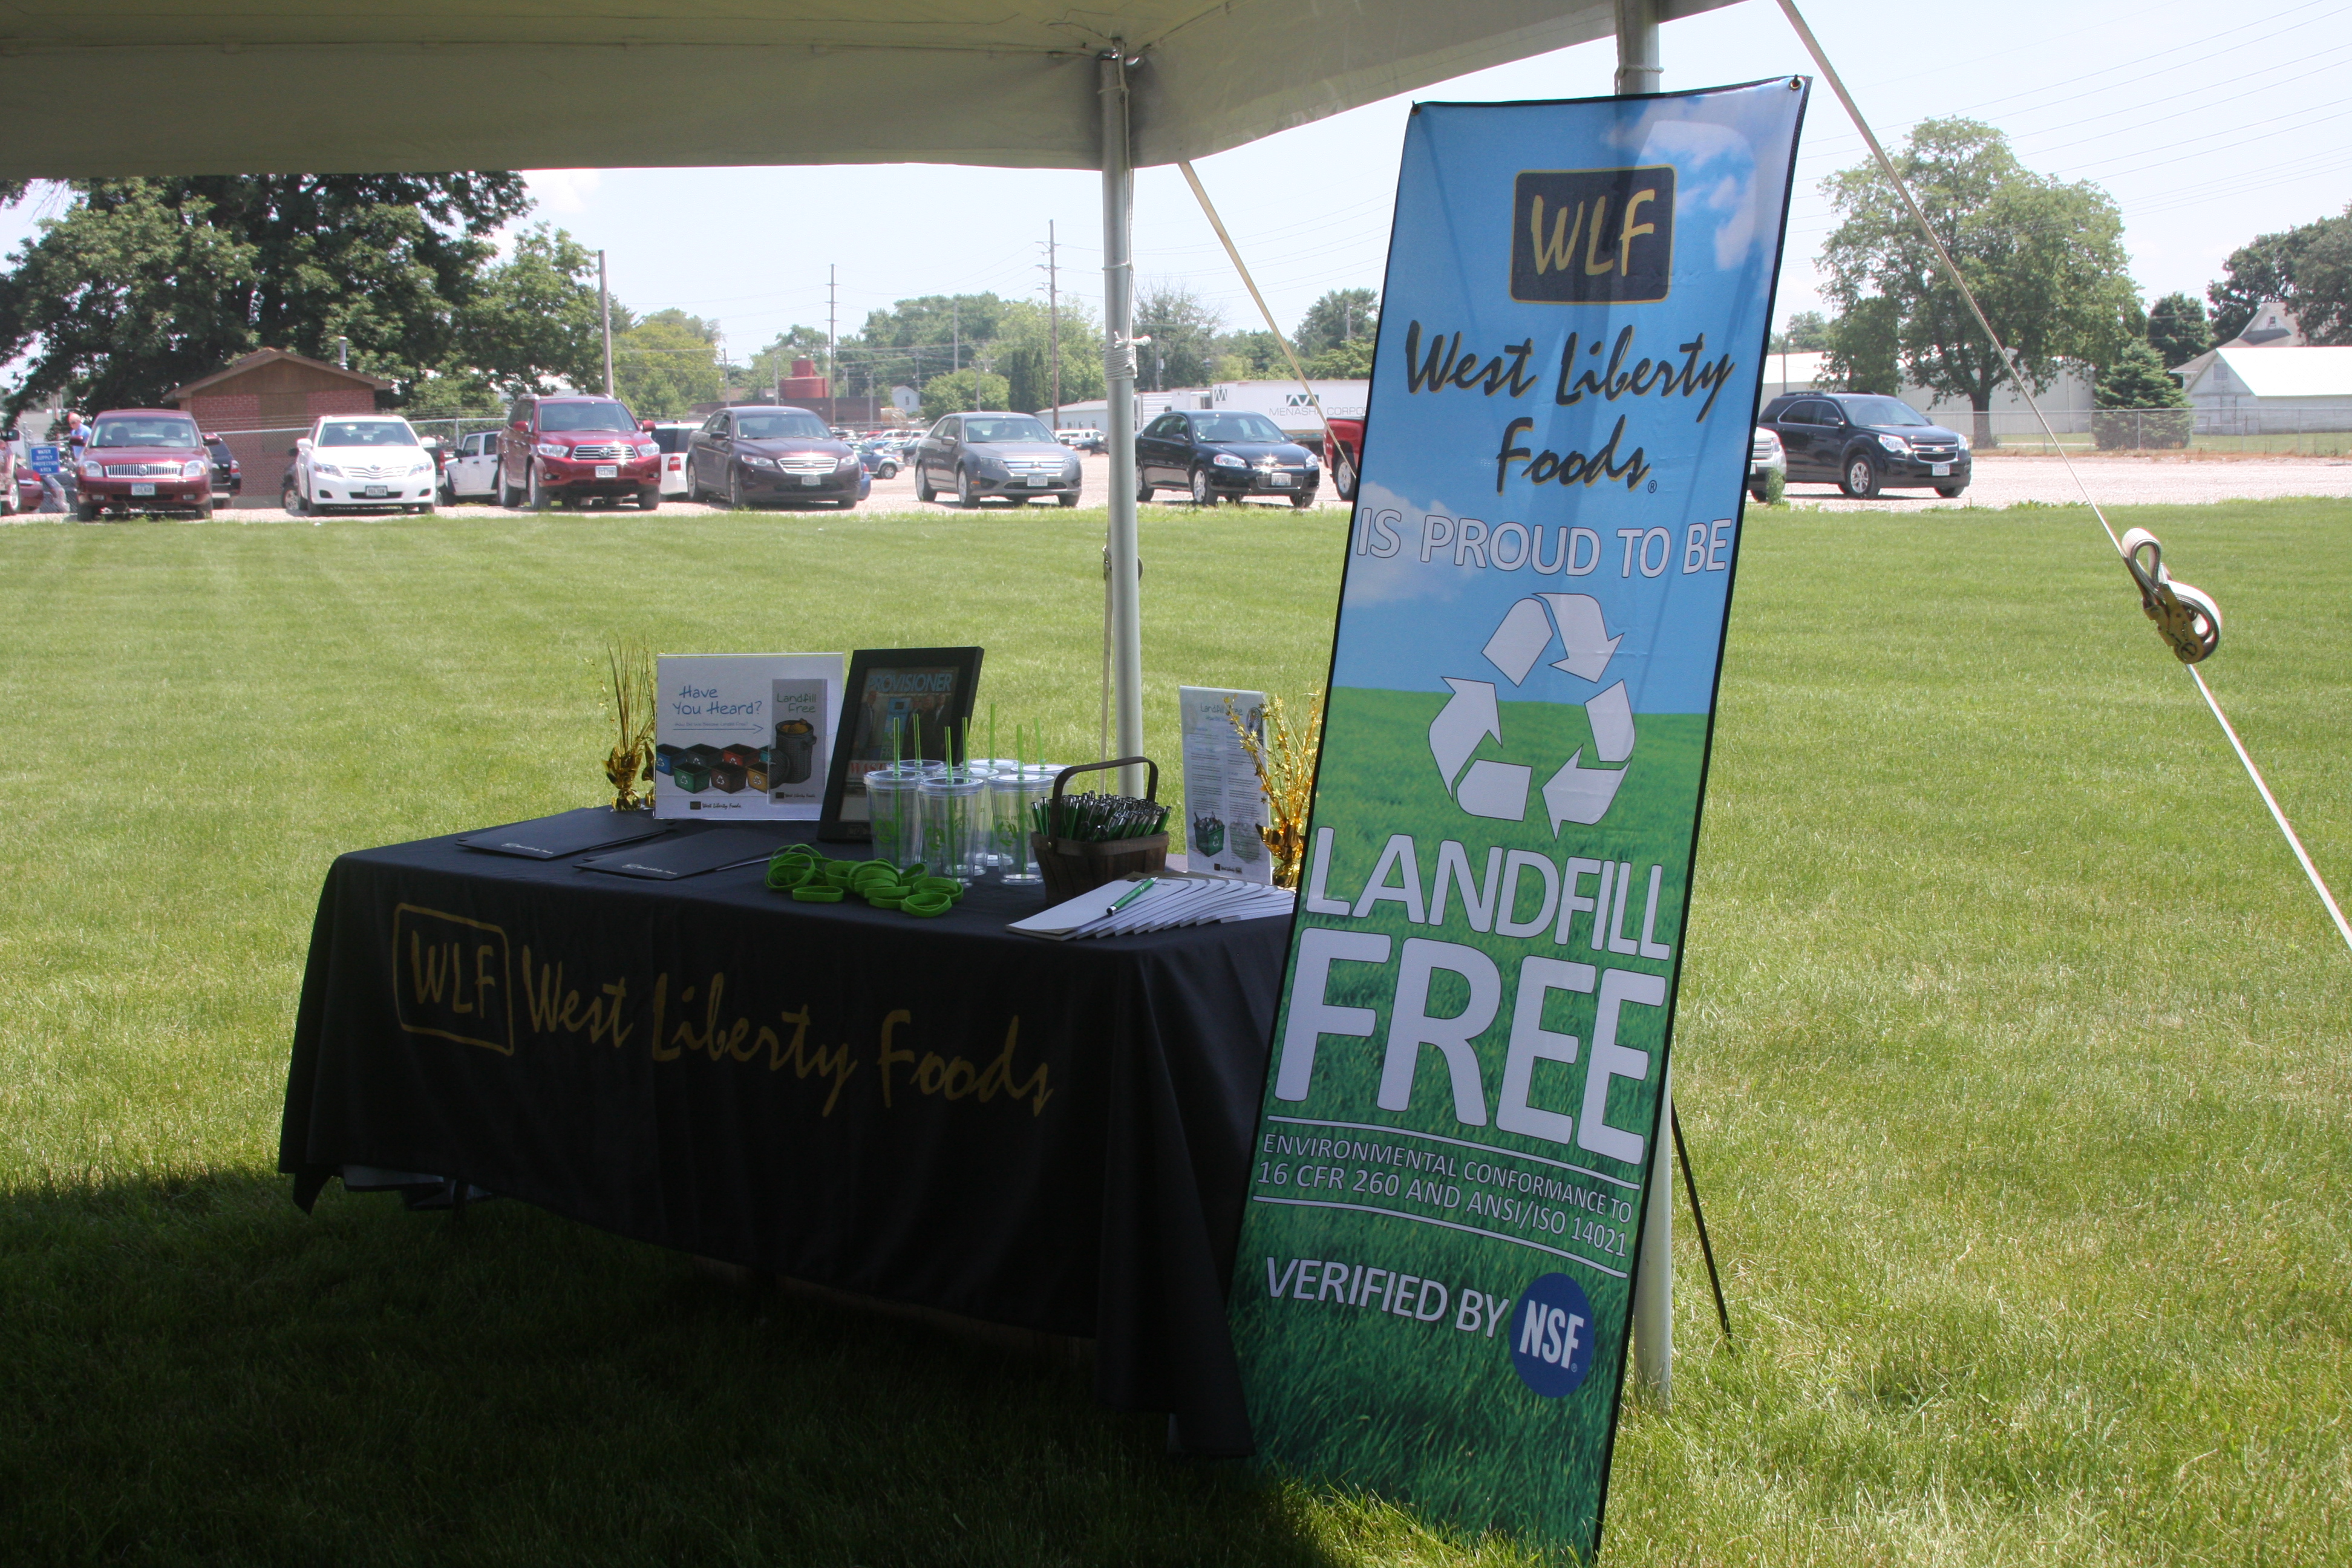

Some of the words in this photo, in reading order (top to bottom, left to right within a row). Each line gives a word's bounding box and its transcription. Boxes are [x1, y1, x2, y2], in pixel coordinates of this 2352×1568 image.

[1531, 189, 1656, 276] WLF
[1405, 319, 1538, 398] West
[1555, 324, 1735, 423] Liberty
[1356, 507, 1402, 558] IS
[1420, 514, 1601, 577] PROUD
[1616, 526, 1671, 578] TO
[1682, 518, 1732, 575] BE
[672, 701, 701, 715] You
[707, 700, 763, 715] Heard?
[679, 685, 719, 699] Have
[777, 693, 817, 703] Landfill
[788, 702, 816, 713] Free
[866, 673, 953, 693] PROVISIONER
[1305, 826, 1671, 961] LANDFILL
[411, 929, 495, 1018] WLF
[522, 944, 633, 1048] West
[651, 972, 858, 1118] Liberty
[877, 1008, 1054, 1117] Foods
[1274, 927, 1667, 1166] FREE
[1257, 1161, 1289, 1186] 16
[1296, 1165, 1345, 1190] CFR
[1351, 1169, 1400, 1197] 260
[1404, 1178, 1461, 1209] AND
[1465, 1191, 1567, 1235] ANSI/ISO
[1570, 1216, 1627, 1258] 14021
[1263, 1133, 1457, 1177] ENVIRONMENTAL
[1463, 1160, 1607, 1215] CONFORMANCE
[1610, 1197, 1633, 1223] TO
[1266, 1256, 1448, 1322] VERIFIED
[1455, 1288, 1510, 1338] BY
[1518, 1299, 1585, 1370] NSF
